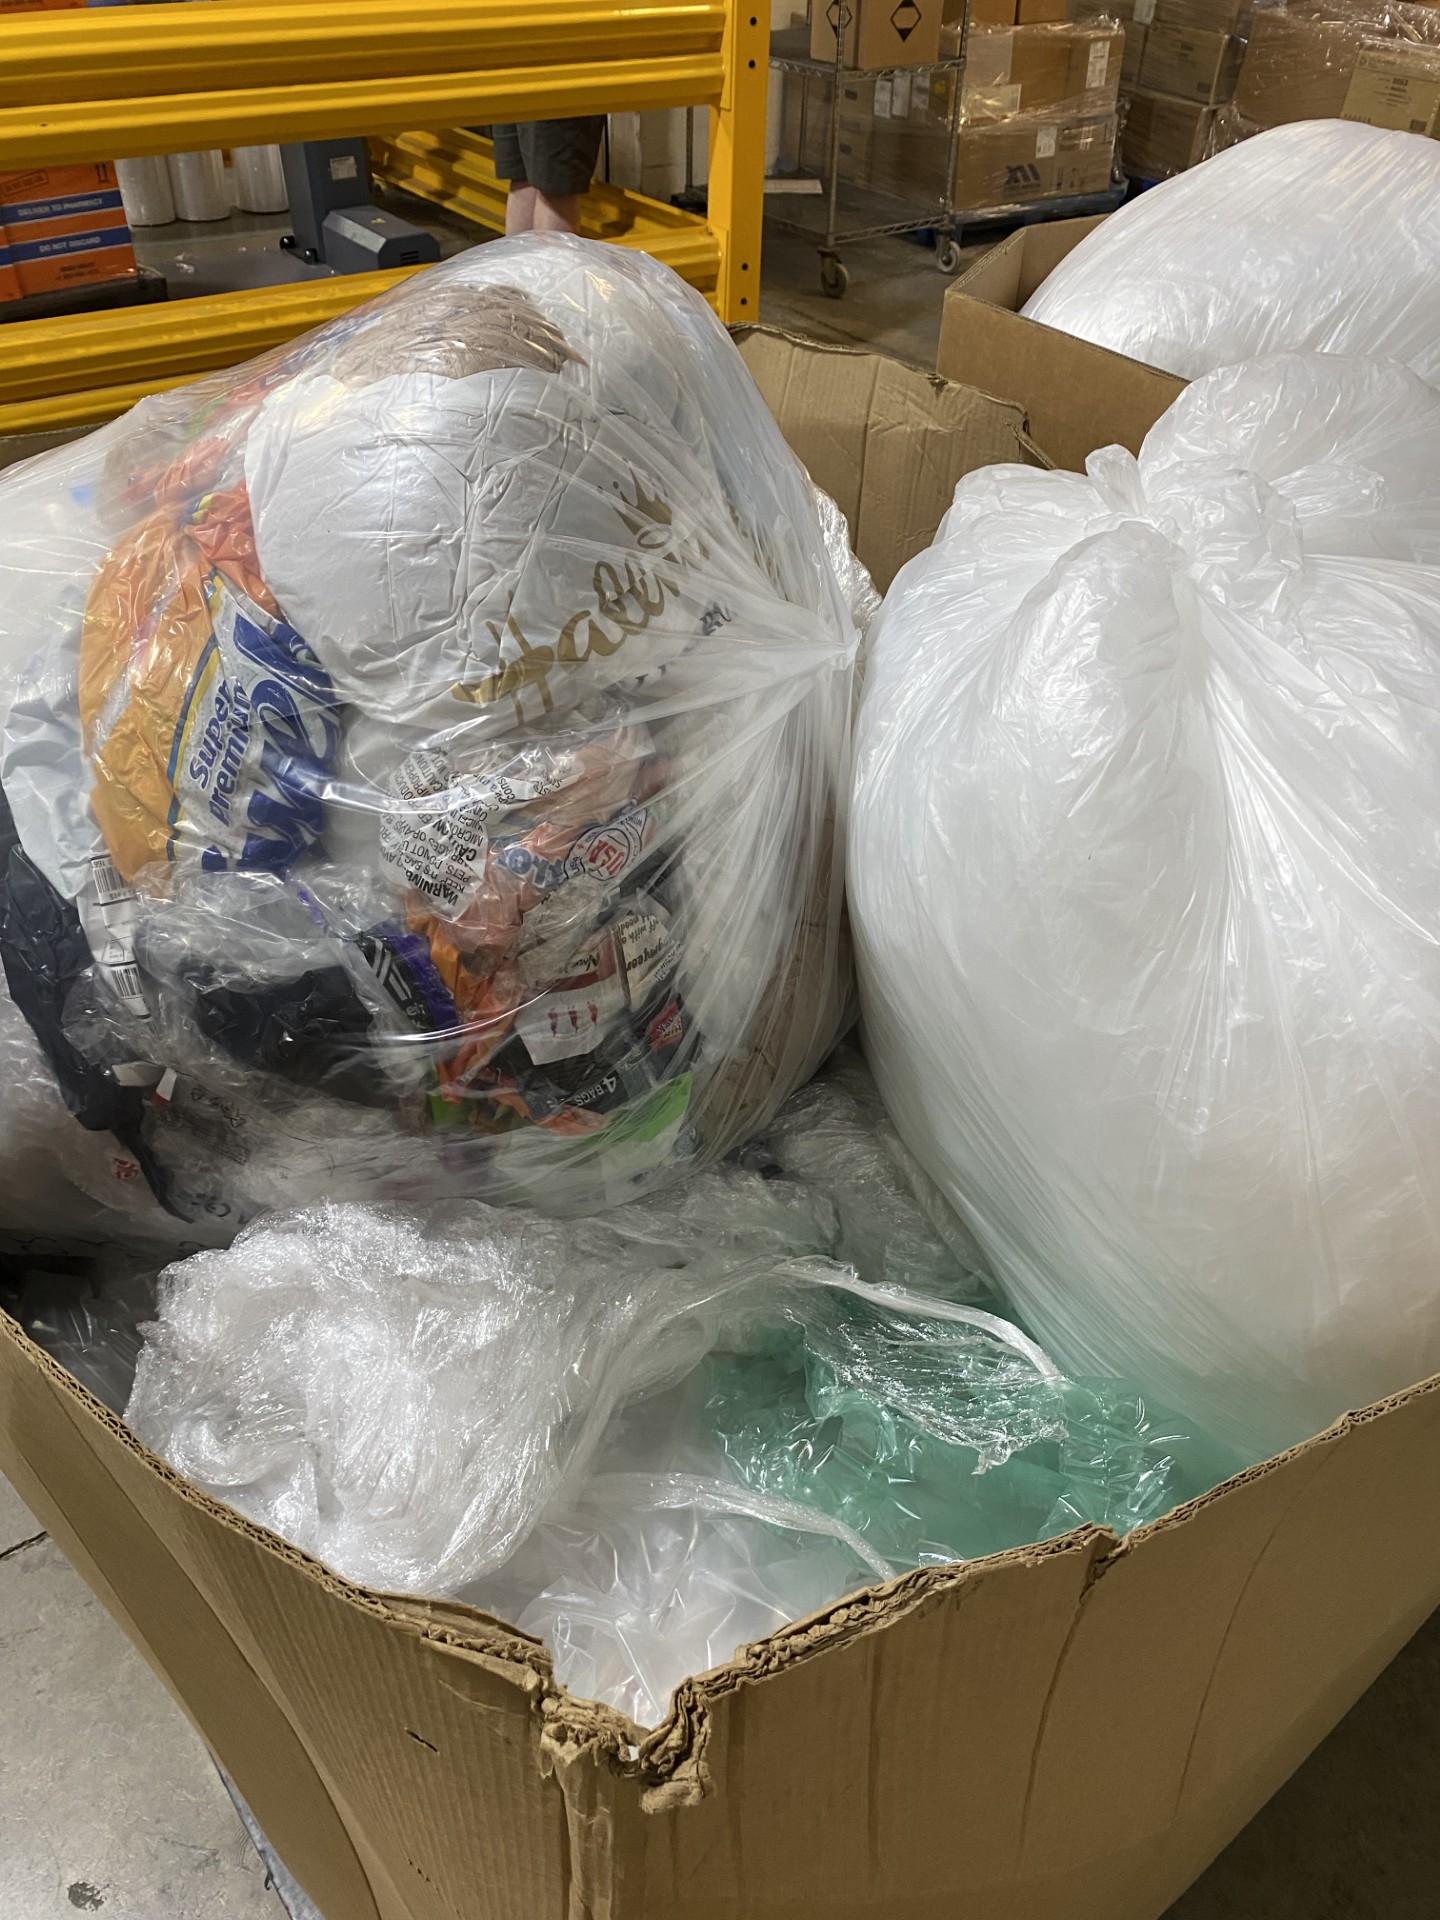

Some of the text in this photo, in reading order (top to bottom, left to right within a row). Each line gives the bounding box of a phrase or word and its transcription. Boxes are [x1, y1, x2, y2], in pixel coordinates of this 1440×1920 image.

[52, 203, 63, 211] TO
[63, 198, 103, 210] PHARMACY
[39, 236, 101, 252] DO NOT DISCARD
[189, 679, 232, 791] Super
[573, 1075, 617, 1107] 4 BAGS
